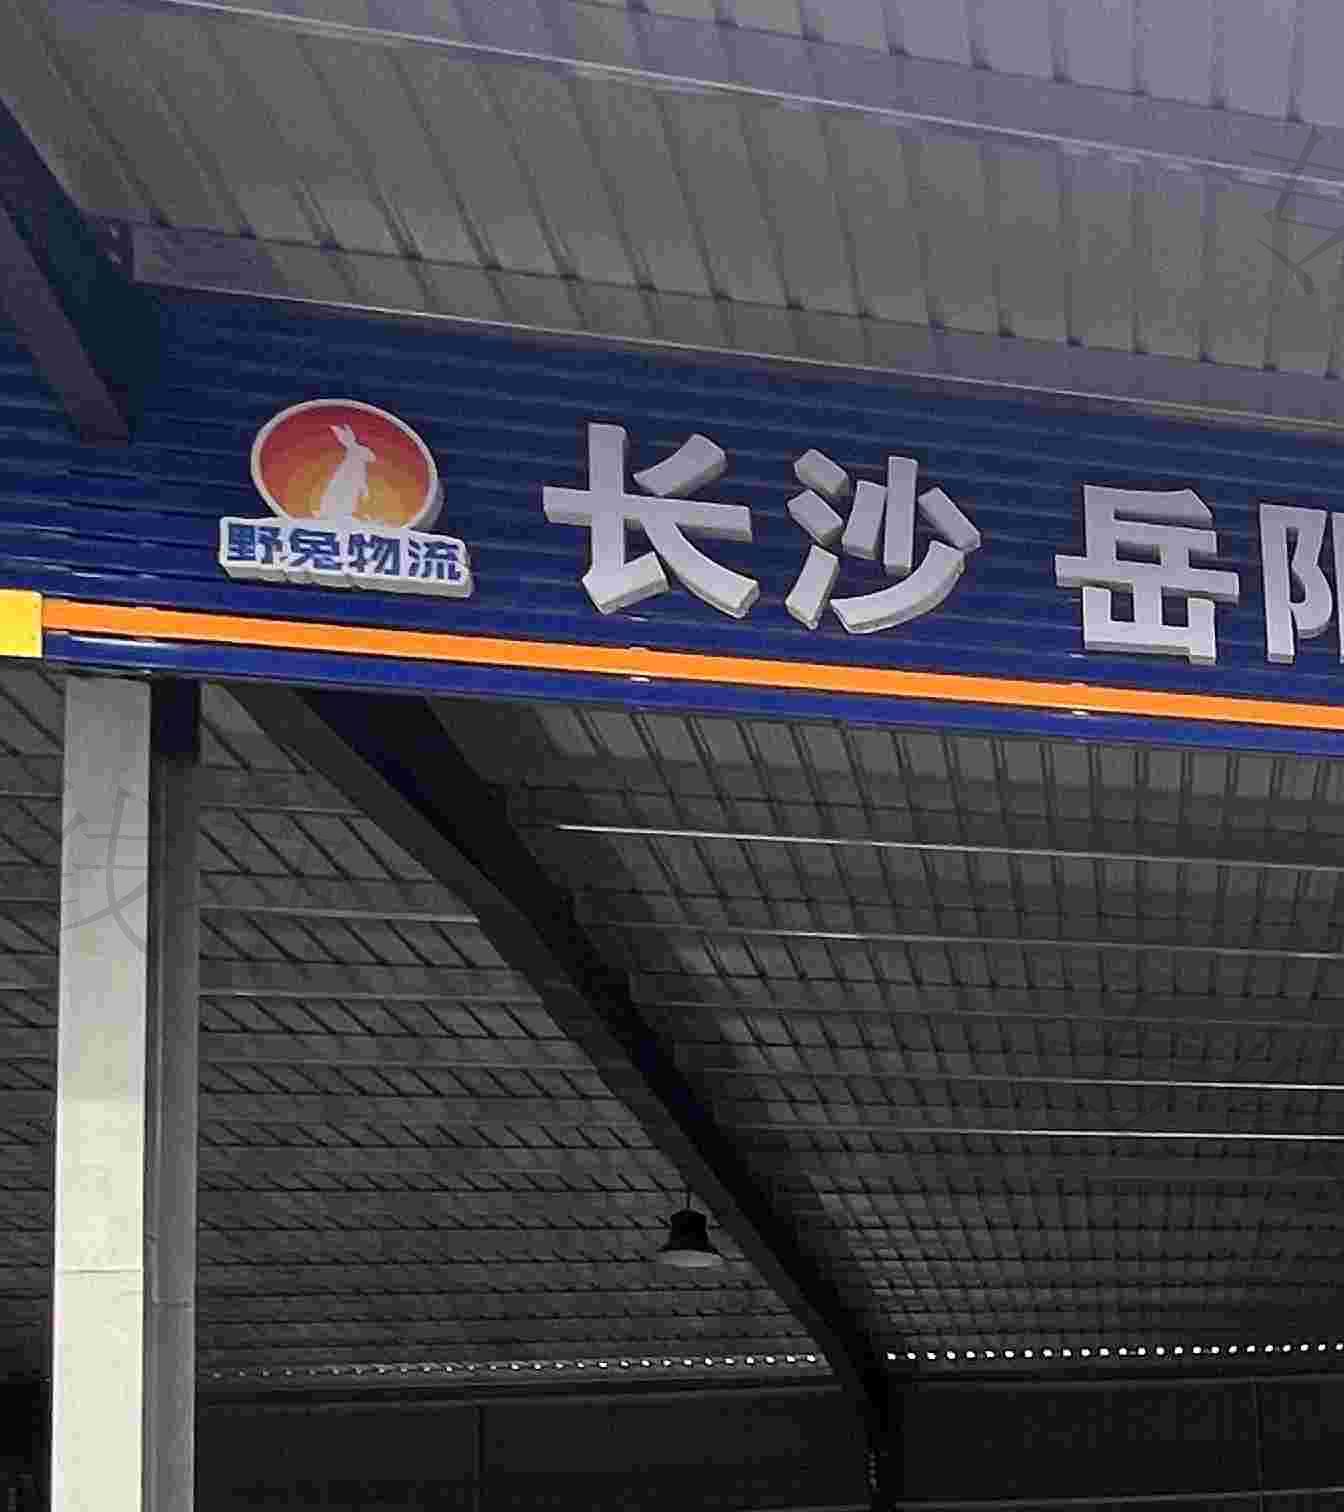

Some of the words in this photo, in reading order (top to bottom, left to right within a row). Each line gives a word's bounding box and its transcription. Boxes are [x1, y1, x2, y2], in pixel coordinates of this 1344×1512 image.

[225, 519, 465, 584] 野兔物流
[543, 423, 982, 634] 长沙
